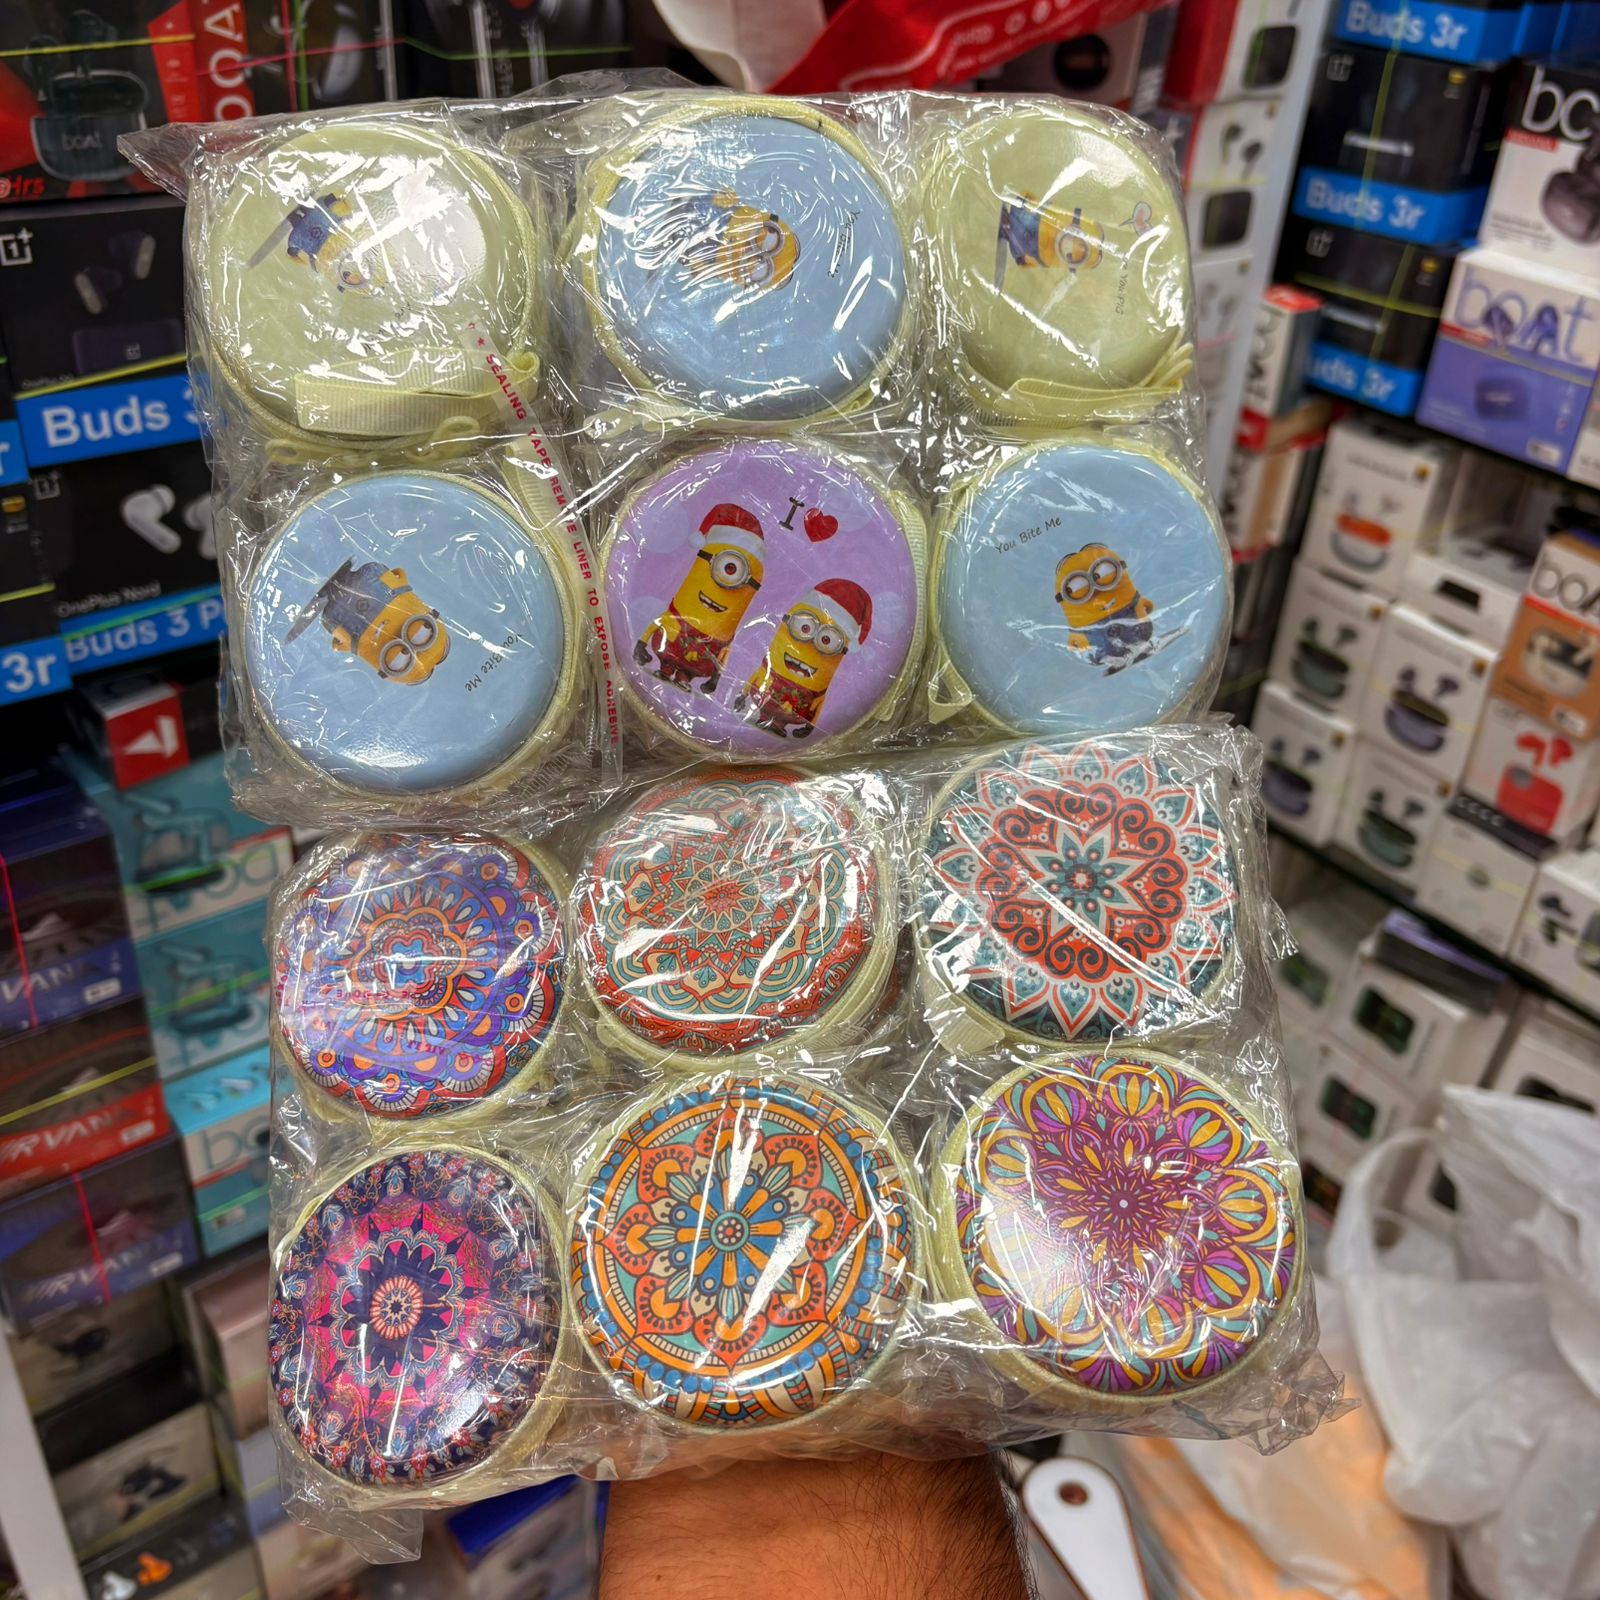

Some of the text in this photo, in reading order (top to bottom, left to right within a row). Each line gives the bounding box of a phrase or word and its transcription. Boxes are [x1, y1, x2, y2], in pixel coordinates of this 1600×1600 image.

[1345, 2, 1467, 49] Buds 3r
[1305, 178, 1425, 229] Buds 3r
[485, 353, 527, 420] SEALING
[42, 396, 171, 448] Buds
[527, 426, 552, 469] TAPE
[549, 476, 577, 534] REME
[779, 496, 805, 531] I
[995, 515, 1063, 555] You Bite Me
[572, 541, 592, 580] LINER
[587, 588, 600, 607] TO
[66, 618, 158, 662] Buds
[166, 606, 190, 637] 3
[593, 616, 611, 671] EXPOSE
[2, 651, 57, 693] 3r
[464, 673, 482, 692] Me
